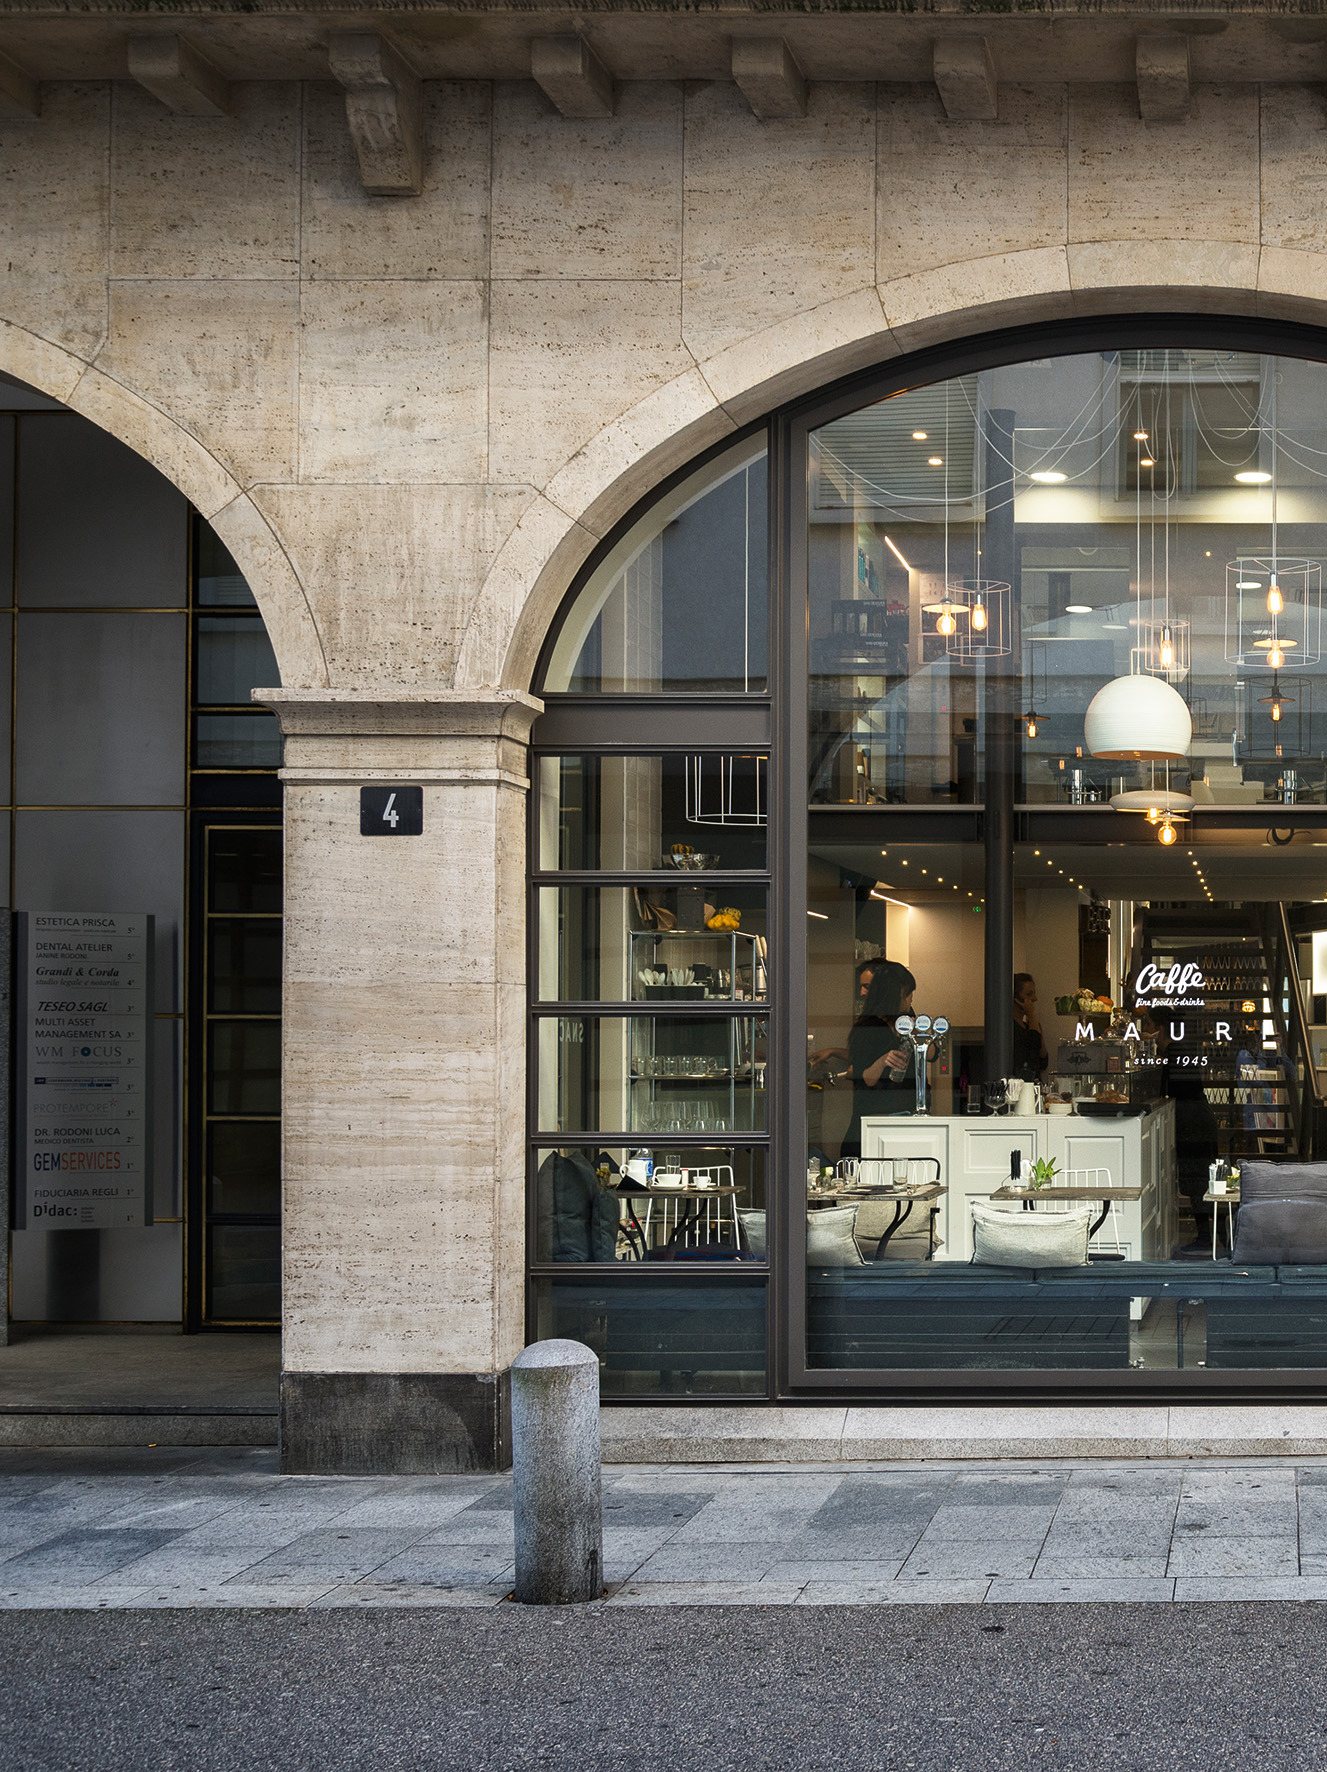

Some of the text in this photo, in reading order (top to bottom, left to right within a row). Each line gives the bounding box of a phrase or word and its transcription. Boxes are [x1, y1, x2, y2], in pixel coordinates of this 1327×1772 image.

[382, 793, 399, 828] 4
[36, 917, 116, 927] ESTETICA PRISCA
[36, 942, 73, 951] DENTAL
[36, 966, 120, 977] Grandi & Corda
[1135, 962, 1207, 995] Caffè
[37, 1001, 108, 1012] TESEO SAGL
[1135, 997, 1152, 1008] fine
[35, 1018, 96, 1026] MULTI ASSET
[35, 1030, 122, 1039] MANAGEMENT SA
[36, 1046, 122, 1057] WM FOCUS
[1133, 1053, 1209, 1067] since 1945
[33, 1103, 109, 1113] PROTEMPORE
[34, 1127, 121, 1136] DR. RODONI LUCA
[33, 1151, 121, 1171] GEMSERVICES
[34, 1188, 119, 1198] FIDUCIARIA REGLI
